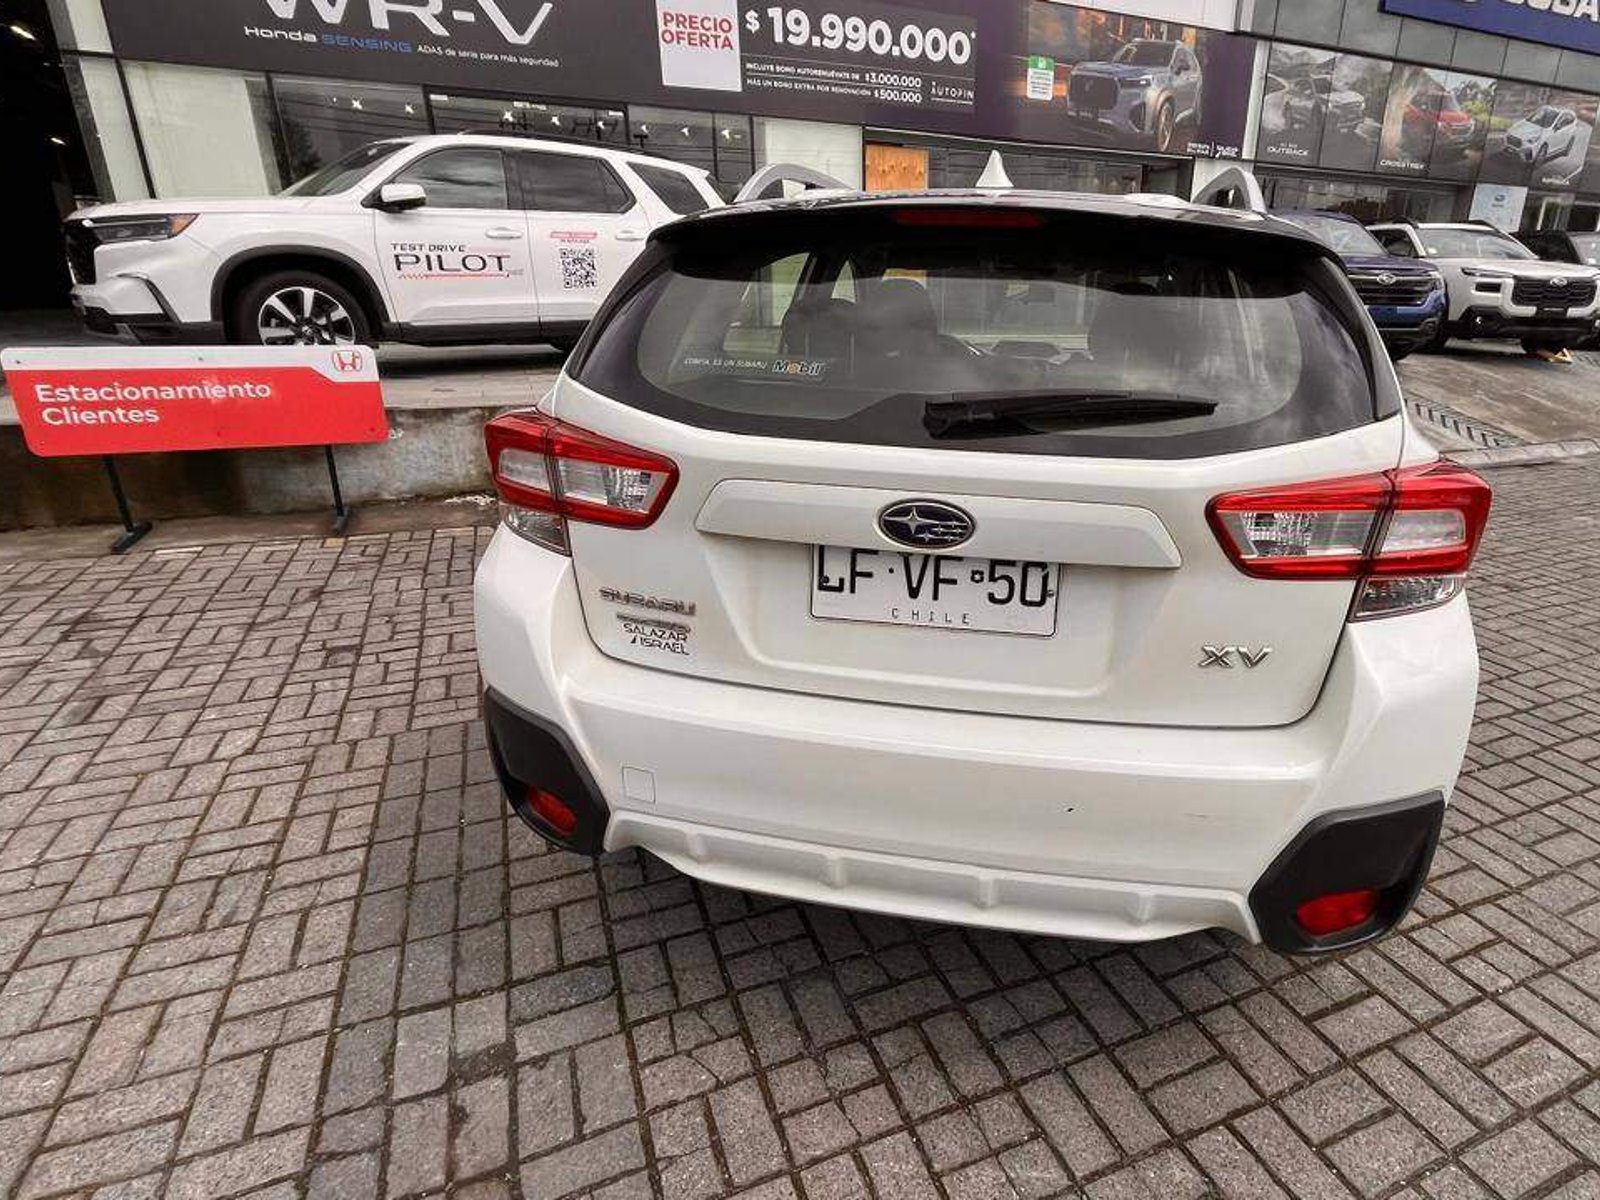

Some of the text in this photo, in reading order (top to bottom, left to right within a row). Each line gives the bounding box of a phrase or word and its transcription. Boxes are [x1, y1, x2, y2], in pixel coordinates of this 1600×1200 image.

[662, 11, 733, 34] PRECIO
[745, 9, 760, 34] $
[244, 25, 413, 53] Honda SENSING
[661, 29, 734, 51] OFERTA
[417, 45, 443, 56] ADAS
[444, 48, 456, 57] de
[458, 50, 478, 60] serie
[480, 52, 499, 62] para
[519, 56, 559, 68] seguridad
[865, 72, 922, 88] $3.000.000
[794, 83, 815, 92] EXTRA
[874, 89, 922, 103] $500.000
[391, 243, 467, 252] TEST DRIVE
[394, 254, 511, 273] PILOT
[772, 359, 821, 376] Mobil
[34, 381, 272, 403] Estacionamiento
[41, 407, 160, 426] Clientes
[599, 586, 696, 616] SUBARU
[891, 607, 971, 624] CHILE
[623, 622, 688, 643] SALAZAR
[639, 636, 690, 656] ISRAEL
[1198, 645, 1272, 668] XV
